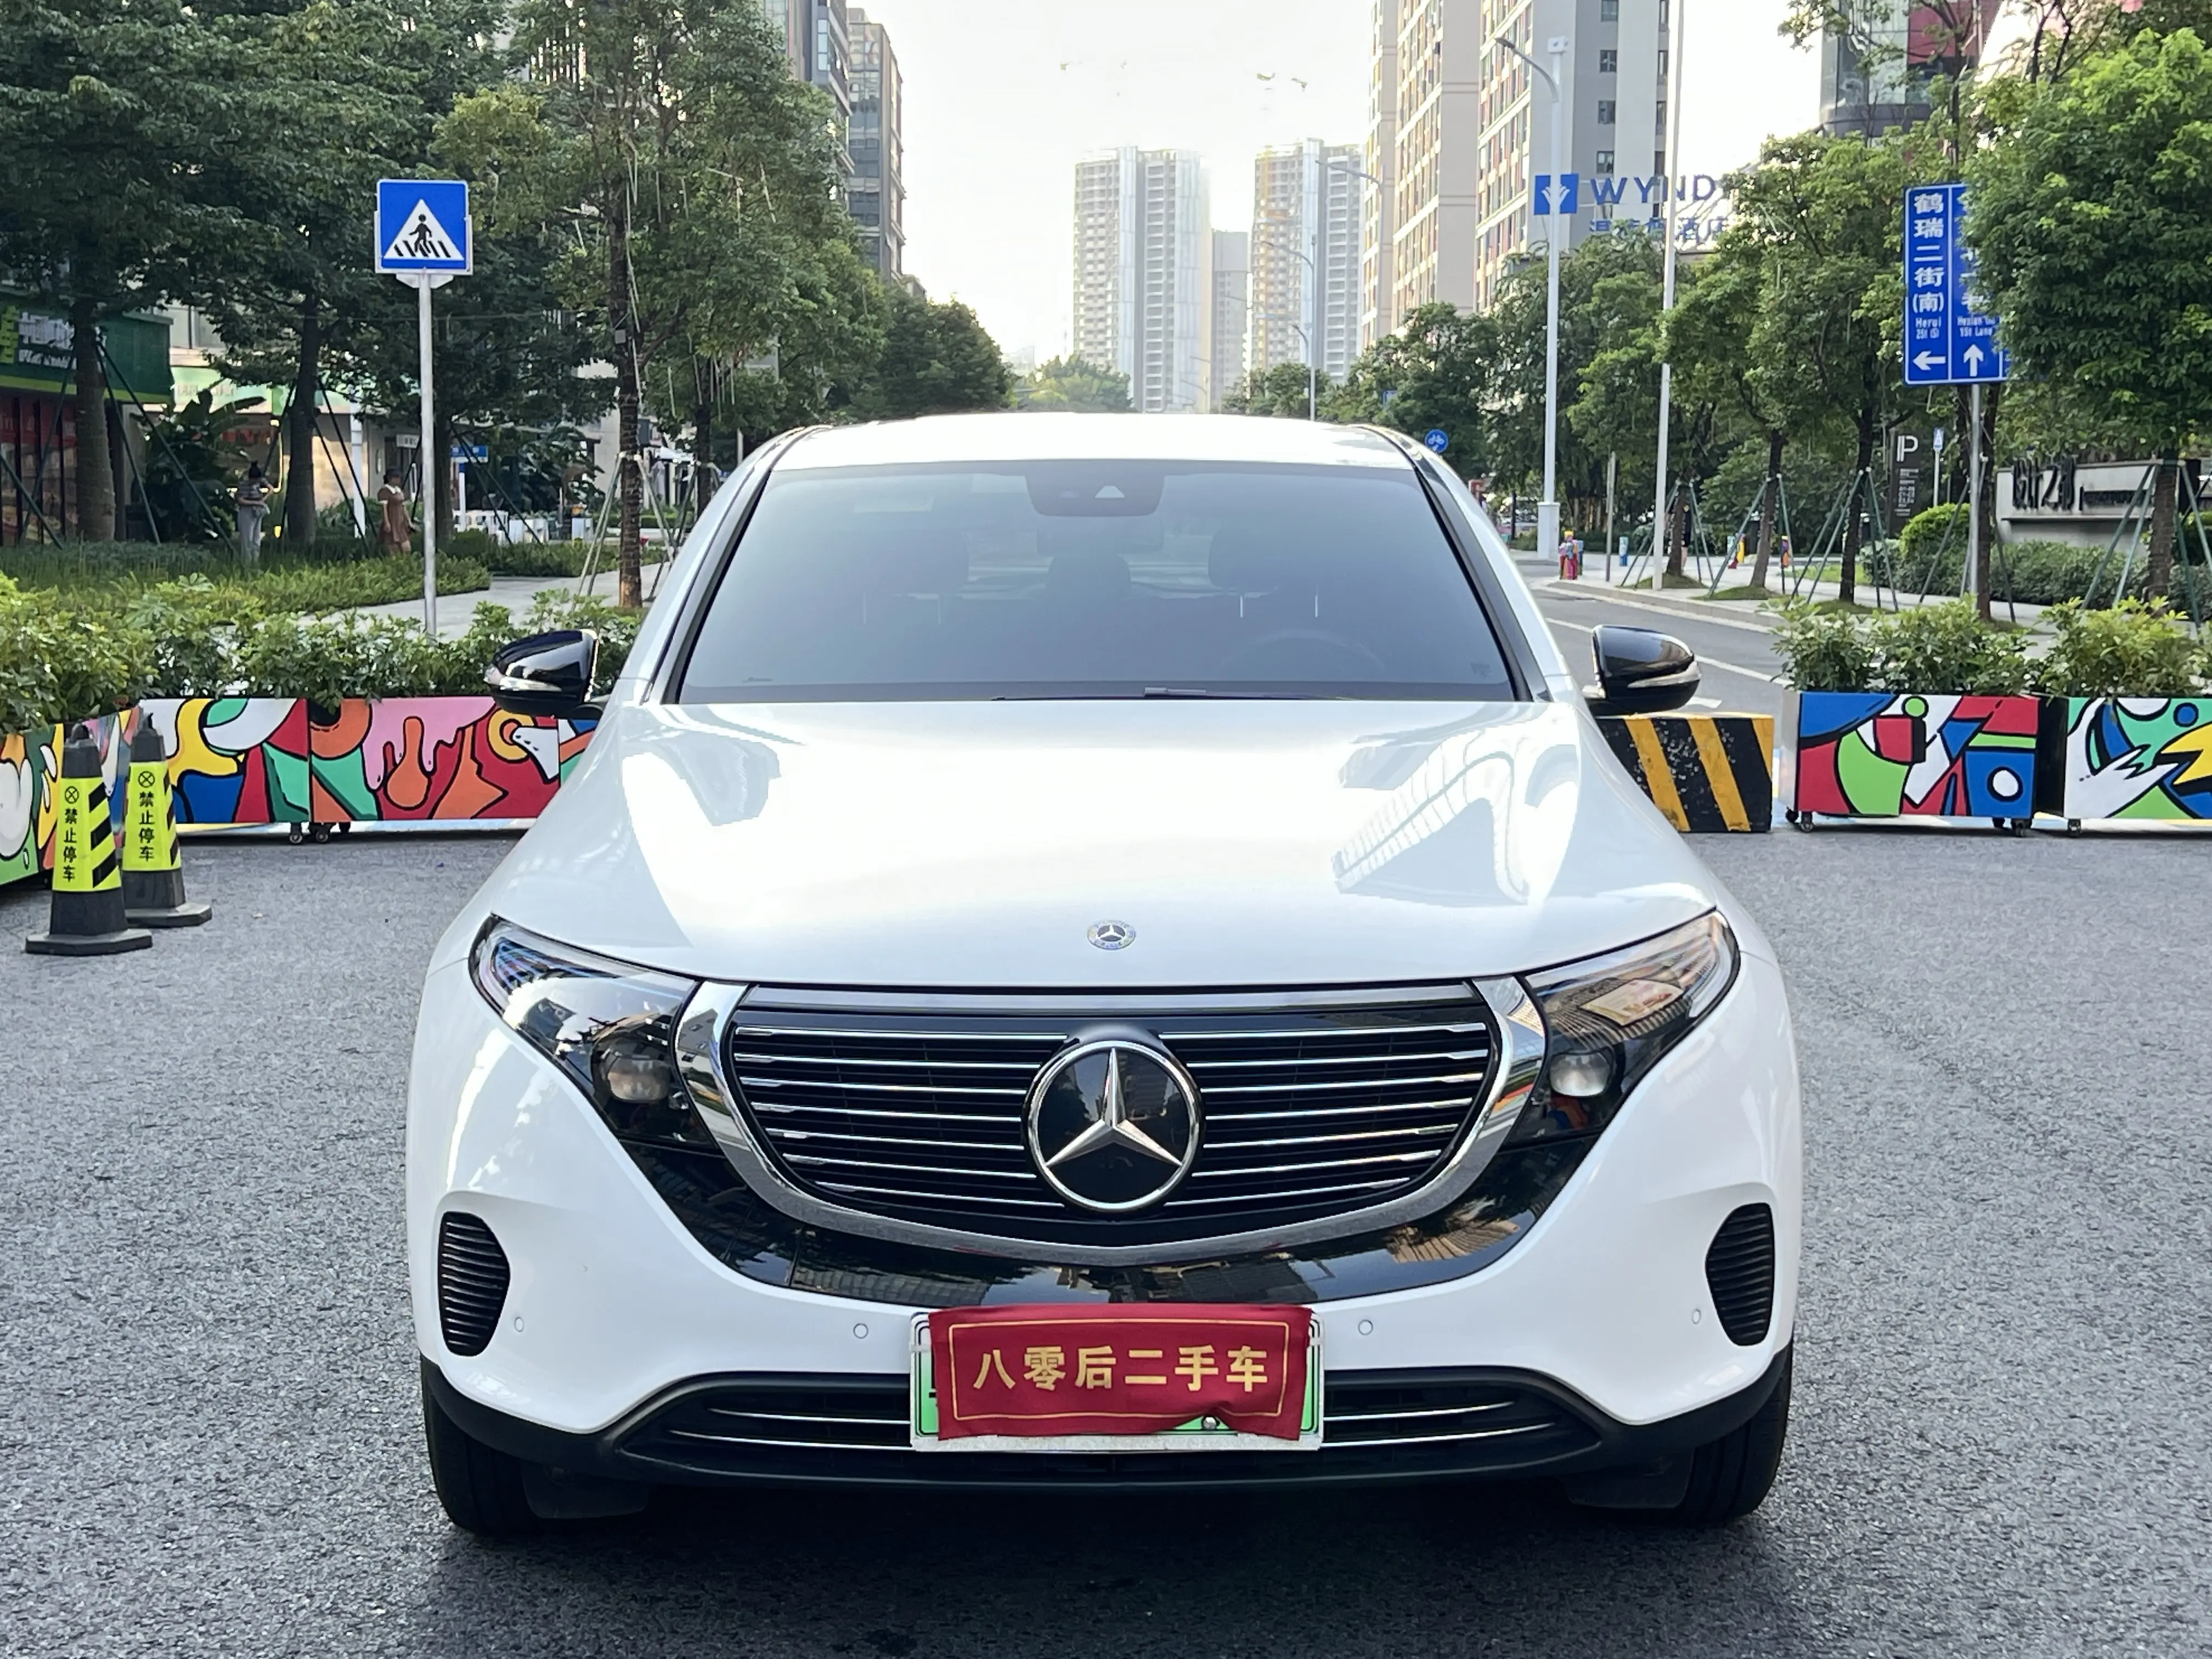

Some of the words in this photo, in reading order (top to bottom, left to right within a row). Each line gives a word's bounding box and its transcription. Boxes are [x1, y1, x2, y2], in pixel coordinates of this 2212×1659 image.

[1912, 193, 1945, 314] 鹤瑞二街(南)
[1896, 435, 1918, 462] P
[63, 808, 78, 882] 禁止停车
[138, 791, 155, 862] 禁止停车
[973, 1345, 1268, 1392] 八零后二手车
